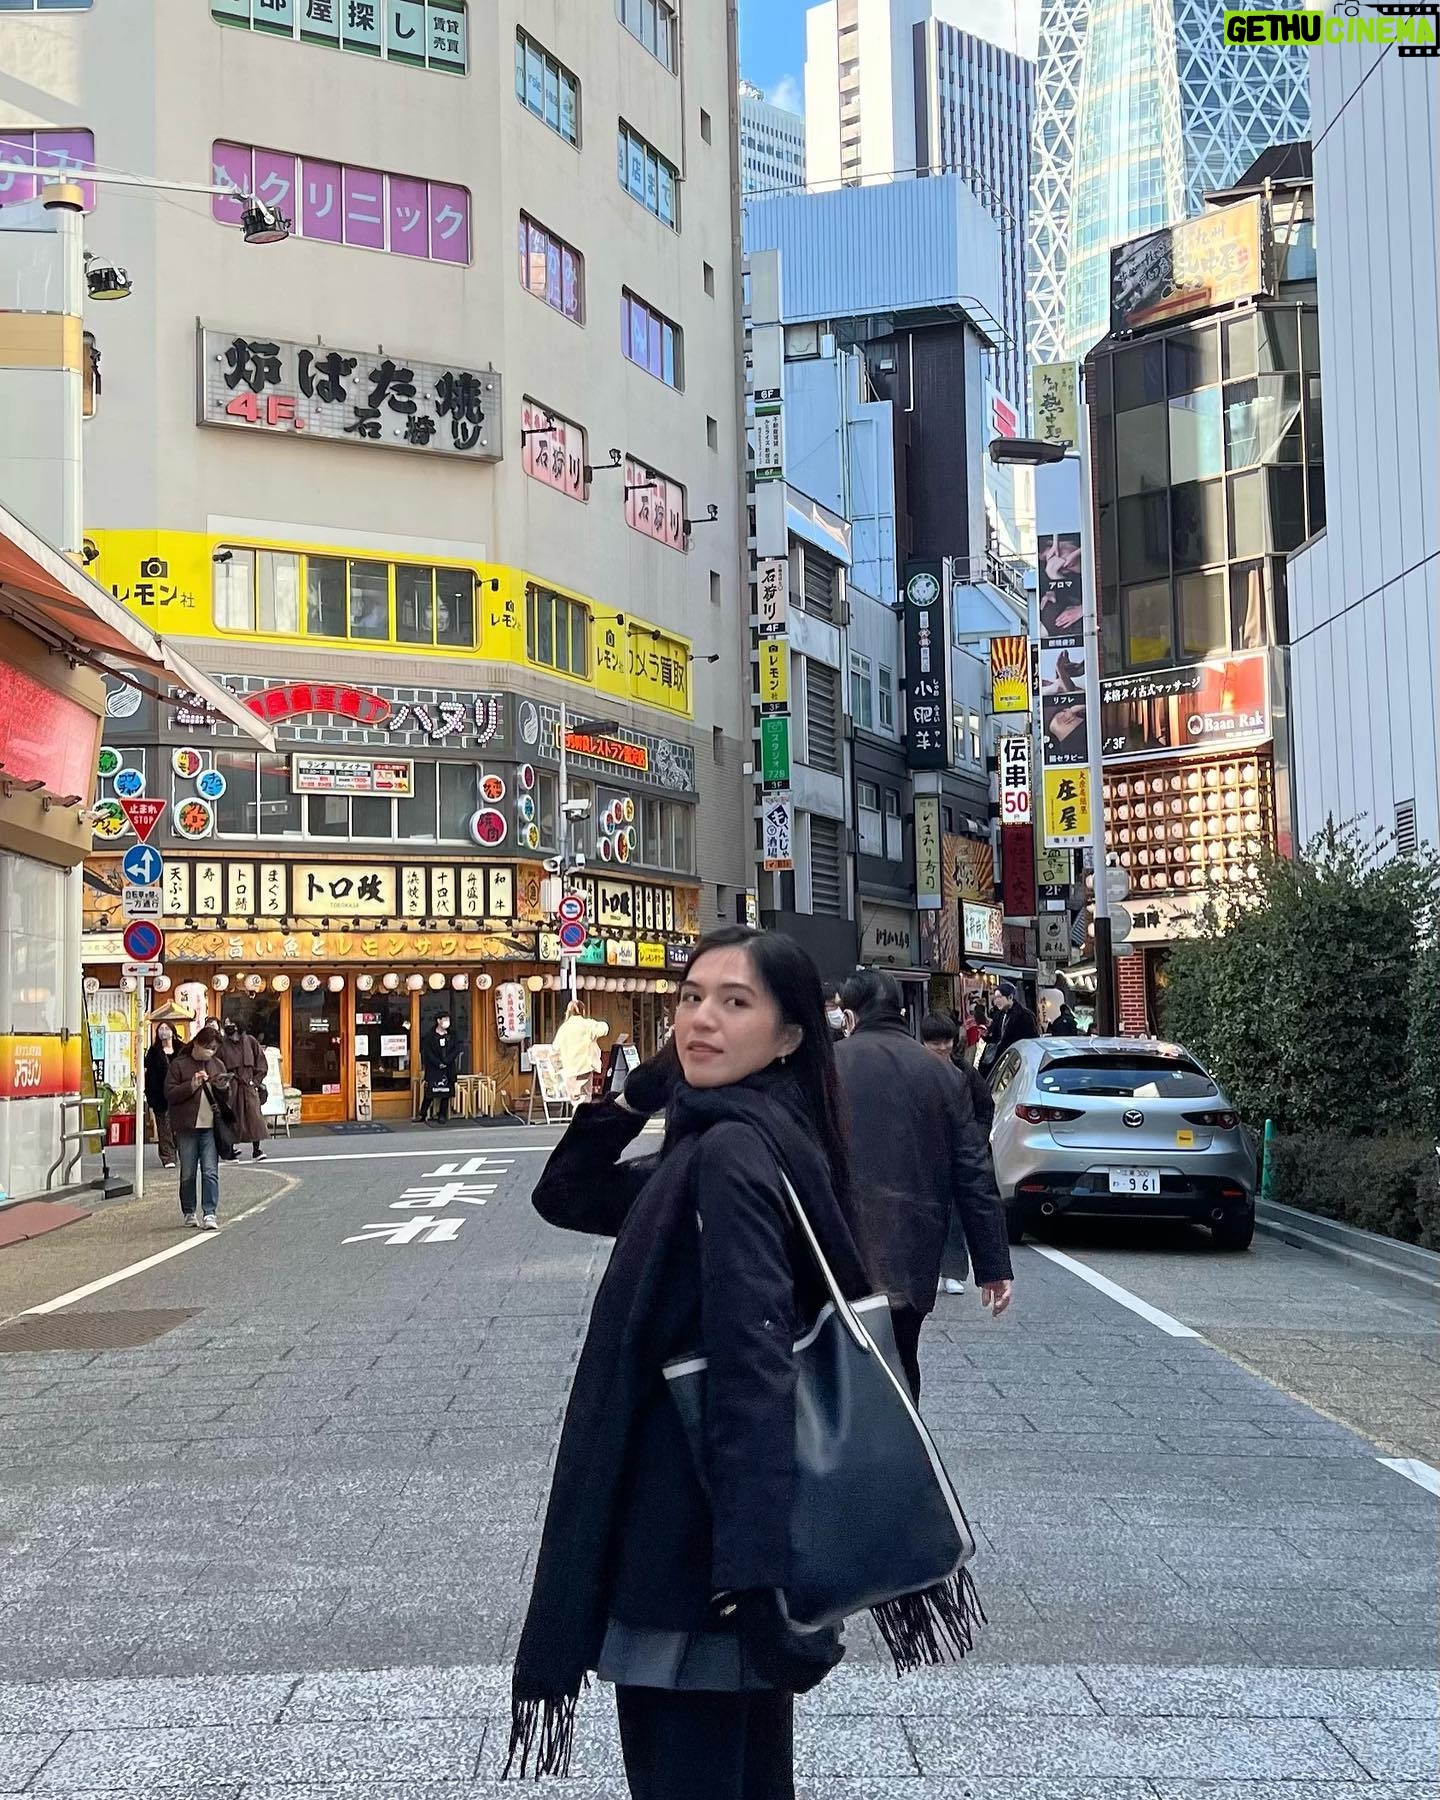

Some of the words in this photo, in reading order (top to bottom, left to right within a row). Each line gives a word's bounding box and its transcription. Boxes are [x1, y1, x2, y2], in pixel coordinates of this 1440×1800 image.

[233, 0, 416, 39] 屋探し
[224, 337, 485, 424] 炉ばた焼
[760, 389, 774, 400] 6F
[112, 583, 195, 609] レモン社
[1048, 580, 1073, 590] アロマ
[765, 623, 779, 633] 4F
[769, 703, 780, 712] 3F
[1053, 696, 1075, 706] リフレ
[389, 698, 498, 745] ハヌリ
[1204, 718, 1235, 733] Baan
[1238, 710, 1264, 728] Rak
[1112, 736, 1126, 750] 3F
[768, 769, 786, 779] 728
[1003, 739, 1027, 788] 伝串
[771, 781, 783, 789] 3F
[128, 803, 158, 814] 止まれ
[1004, 791, 1029, 813] 50
[1056, 778, 1079, 832] 庄屋
[133, 815, 154, 825] STOP
[170, 866, 183, 911] 天ぷら
[203, 867, 216, 911] 寿司
[268, 869, 281, 911] まぐろ
[307, 871, 386, 904] トロ政
[437, 872, 450, 913] 十四代
[494, 872, 507, 911] 和牛
[341, 1156, 516, 1245] 止まれ
